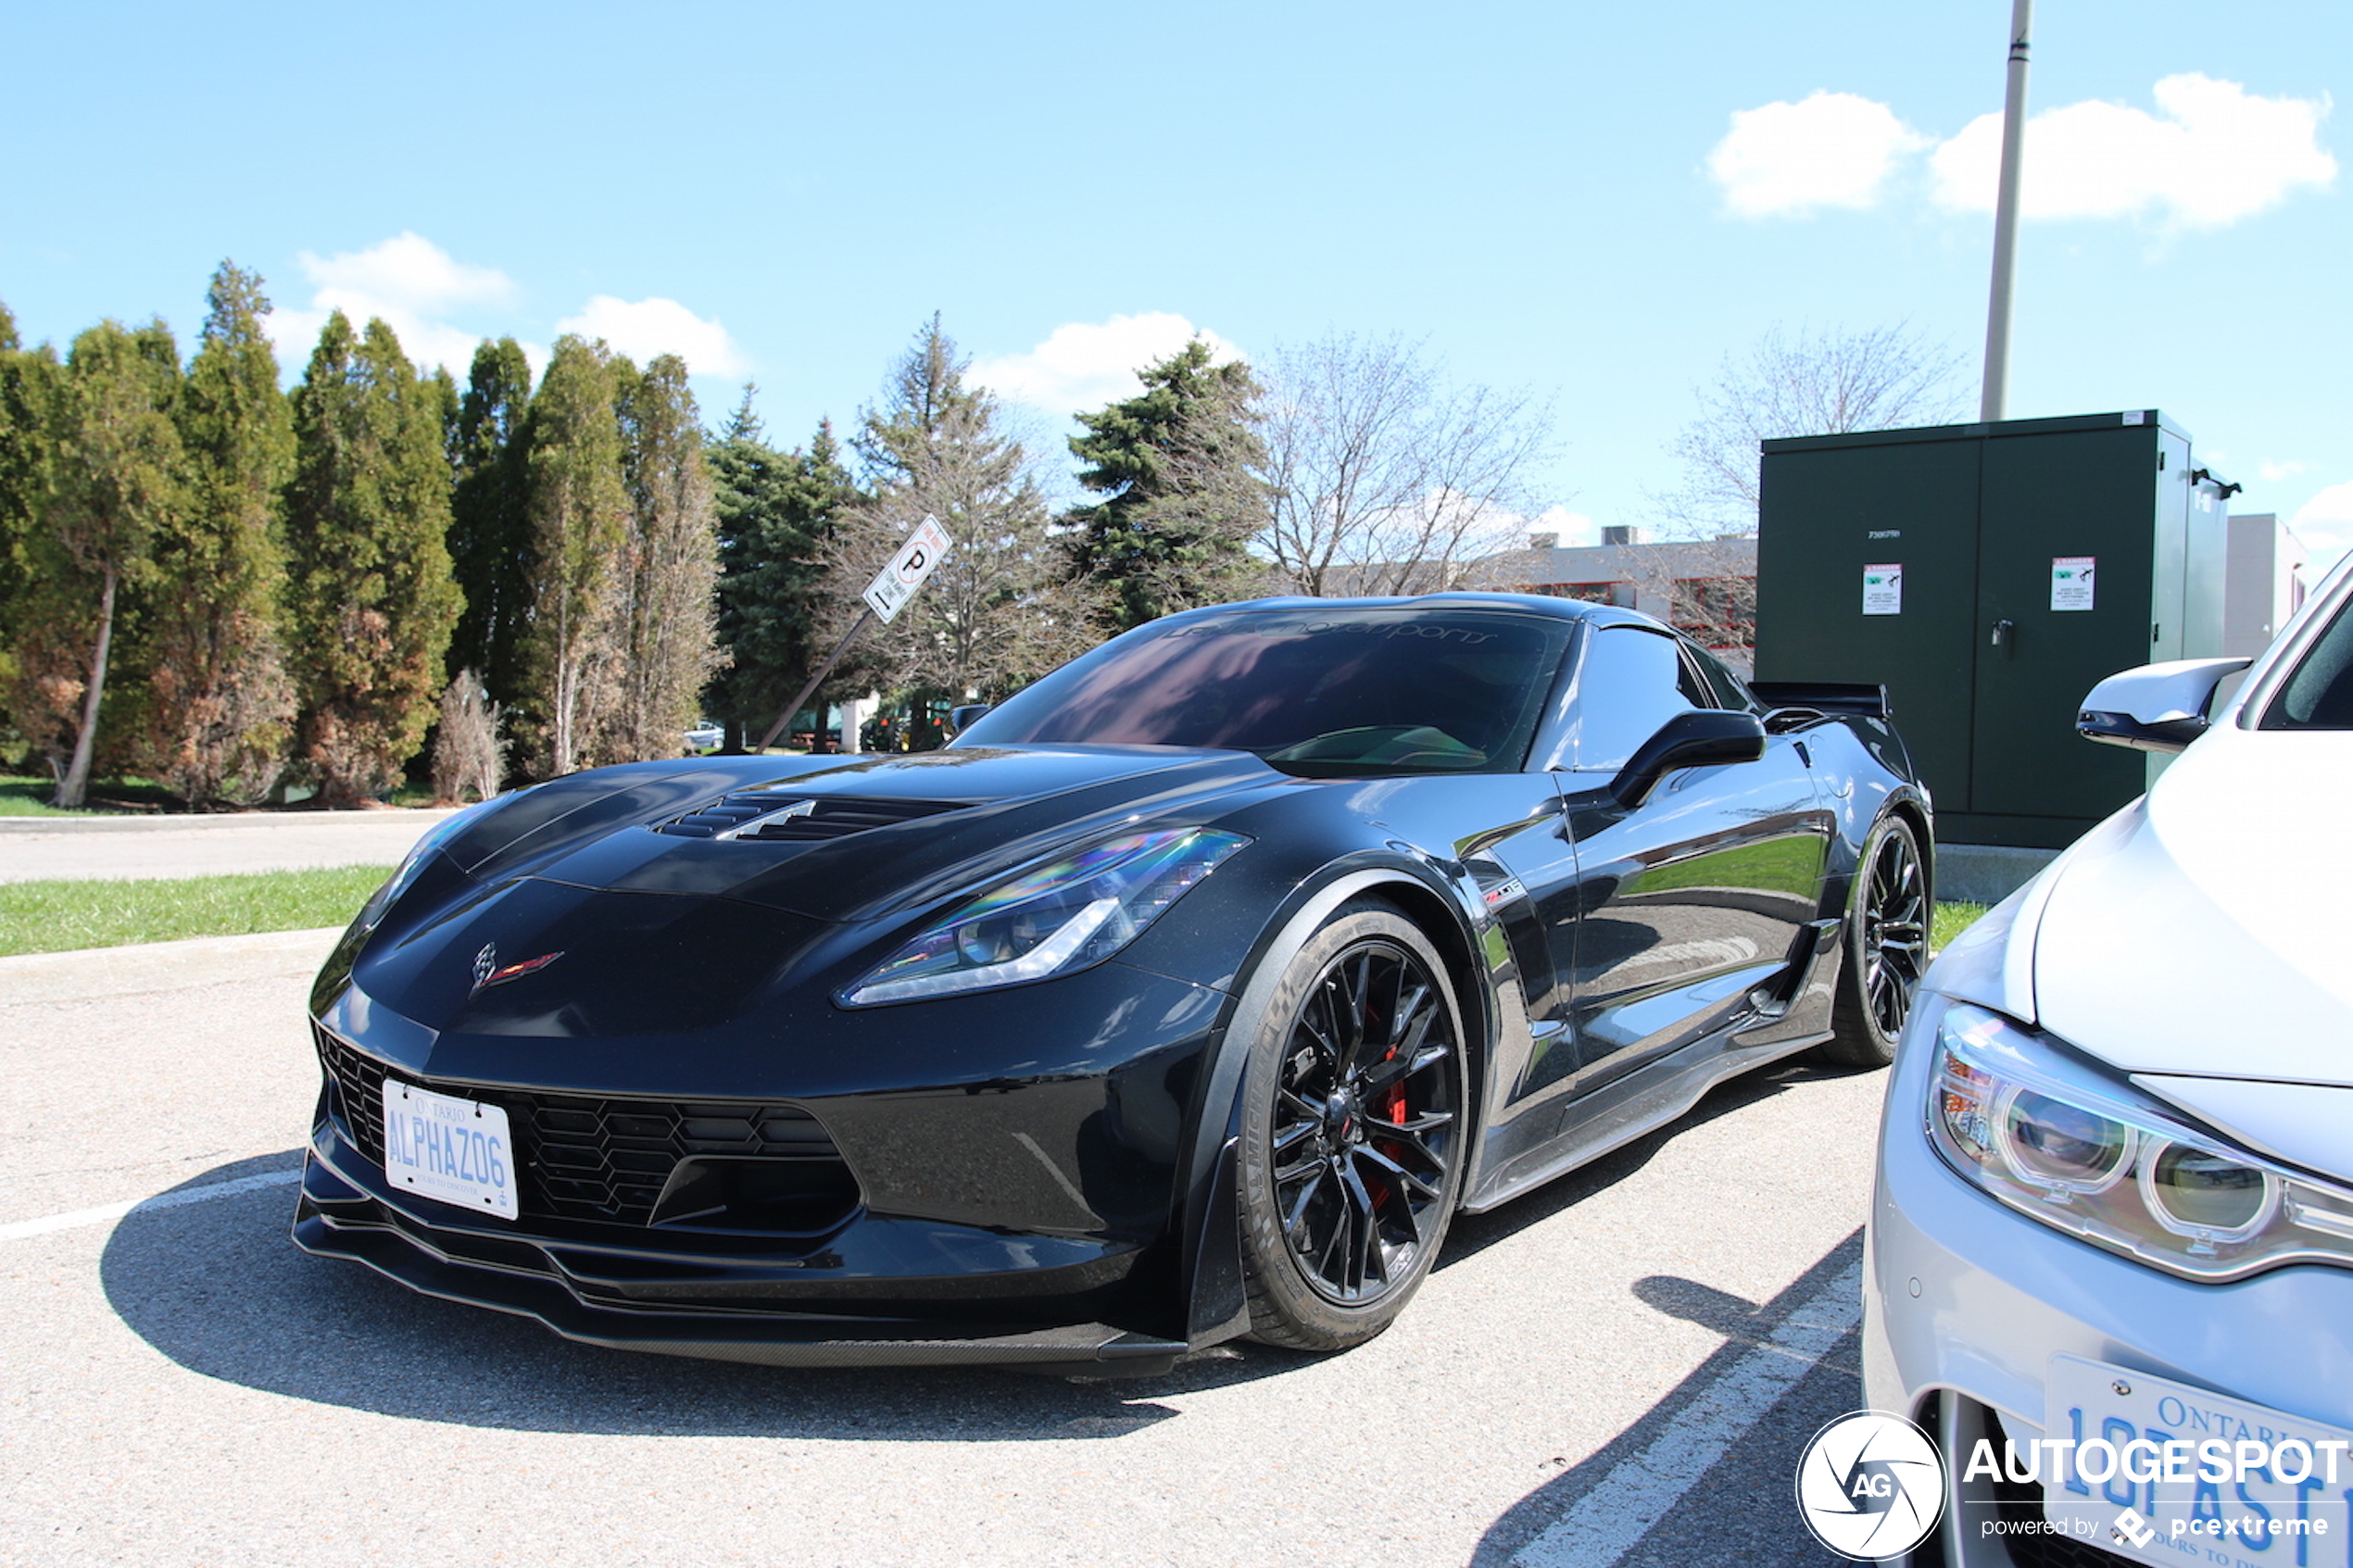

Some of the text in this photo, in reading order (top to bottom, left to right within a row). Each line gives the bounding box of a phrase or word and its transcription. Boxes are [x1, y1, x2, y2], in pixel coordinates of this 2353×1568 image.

[415, 1097, 465, 1123] ONTARIO
[389, 1110, 505, 1188] ALPHAZ06
[2204, 1549, 2229, 1567] TO
